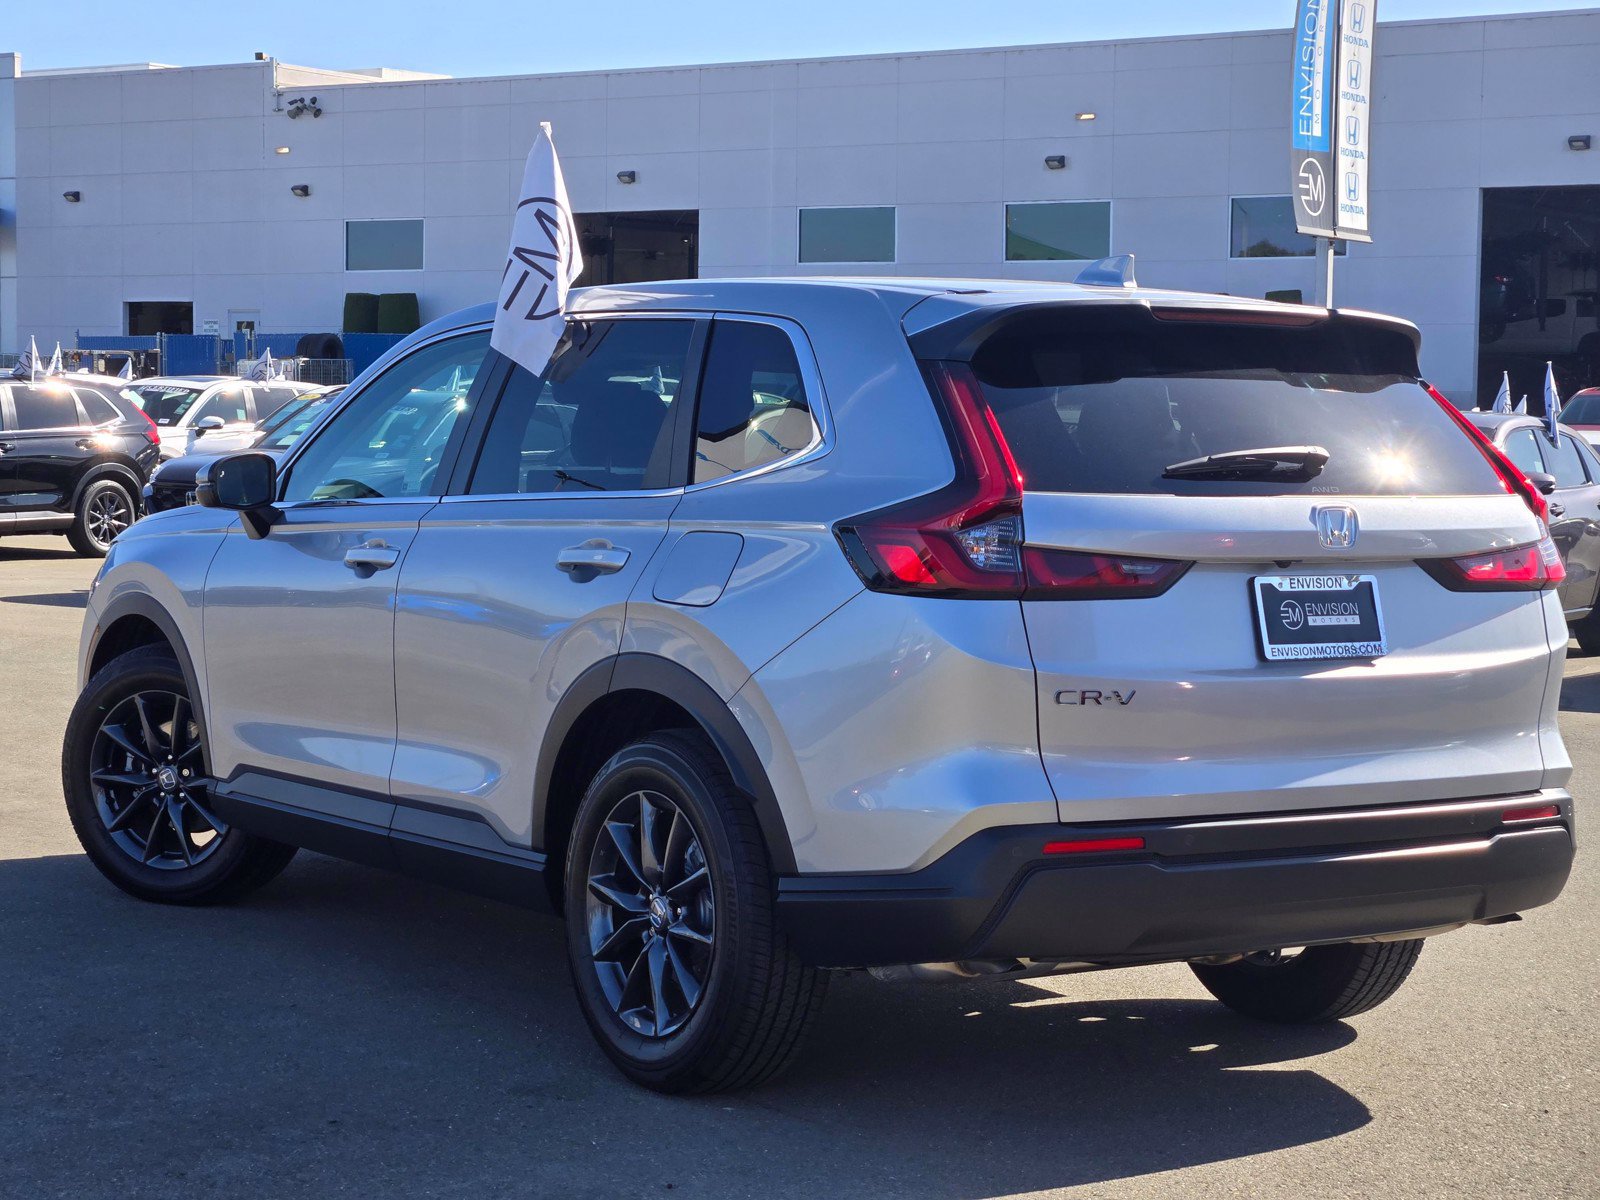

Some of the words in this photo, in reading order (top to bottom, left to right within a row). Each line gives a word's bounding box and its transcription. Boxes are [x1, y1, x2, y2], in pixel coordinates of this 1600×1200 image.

[1343, 34, 1369, 48] HONDA
[1342, 91, 1367, 104] HONDA
[1340, 147, 1365, 160] HONDA
[1340, 203, 1365, 215] HONDA
[1289, 577, 1342, 589] ENVISION
[1304, 602, 1359, 616] ENVISION
[1270, 645, 1383, 657] ENVISIONMOTORS.COM
[1054, 690, 1136, 705] CR-V
